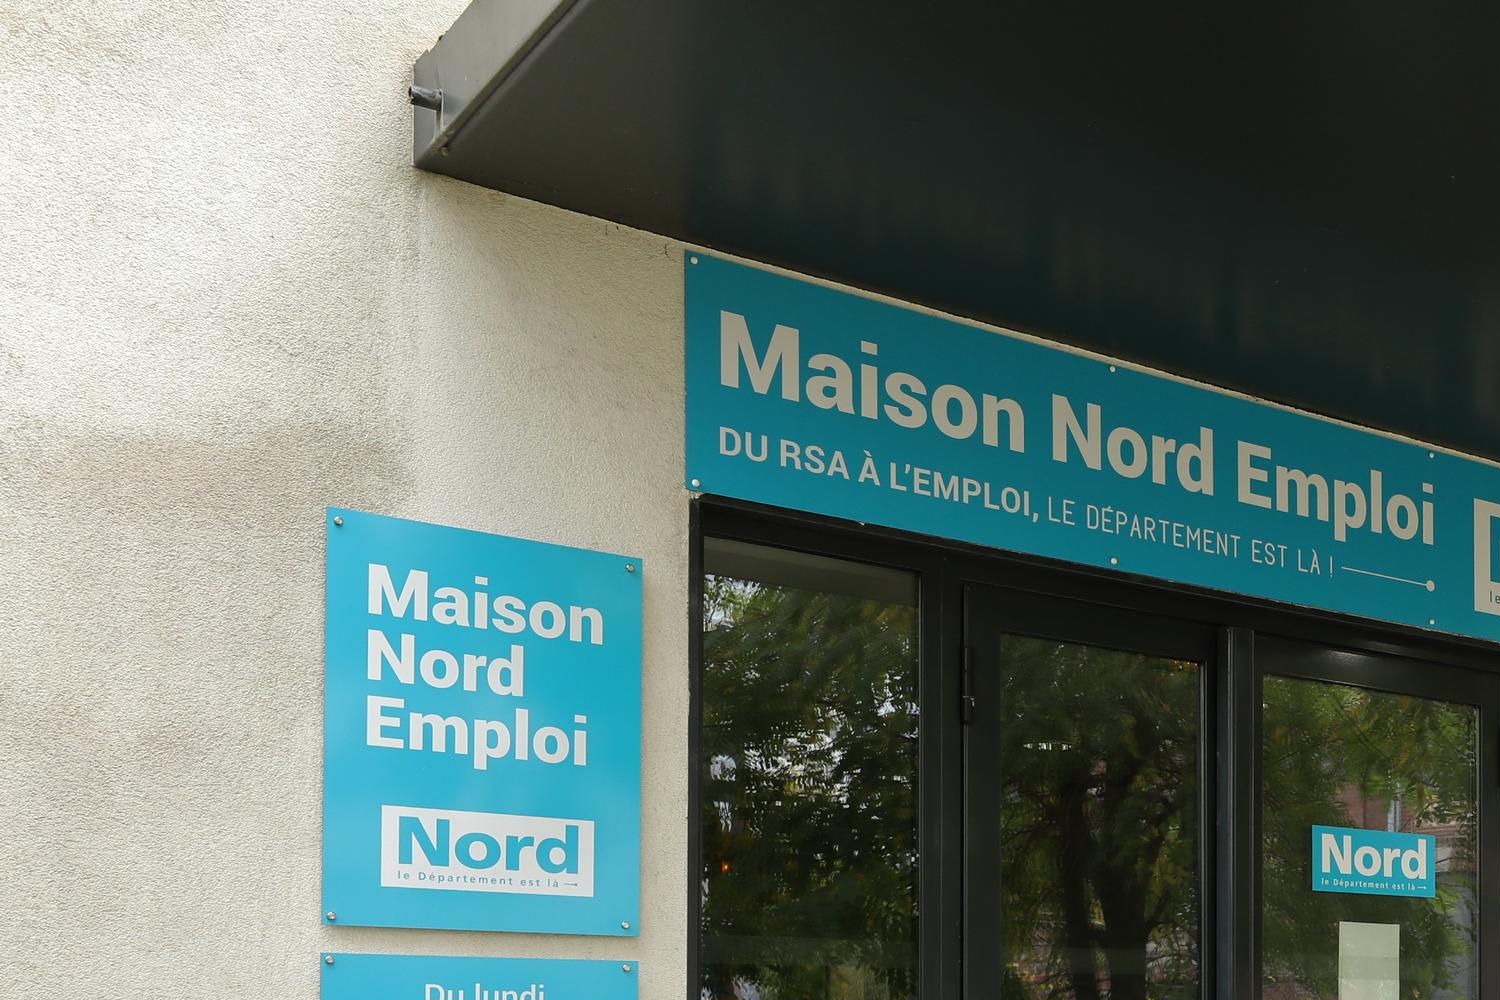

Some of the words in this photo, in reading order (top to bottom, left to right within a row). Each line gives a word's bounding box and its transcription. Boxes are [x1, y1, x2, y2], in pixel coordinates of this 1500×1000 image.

[720, 310, 1026, 454] Maison
[1052, 394, 1215, 496] Nord
[1237, 440, 1435, 546] Emploi
[719, 426, 768, 463] DU
[780, 438, 850, 480] RSA
[858, 449, 881, 486] À
[889, 461, 1040, 524] L’EMPLOI,
[1048, 496, 1076, 526] LE
[1086, 504, 1241, 559] DÉPARTEMENT
[1251, 539, 1288, 568] EST
[367, 562, 604, 646] Maison
[1489, 590, 1500, 604] le
[367, 628, 525, 698] Nord
[366, 694, 588, 771] Emploi
[398, 816, 580, 875] Nord
[1321, 832, 1427, 880] Nord
[397, 870, 410, 880] le
[418, 871, 513, 887] Département
[520, 879, 540, 887] est
[547, 879, 559, 888] là
[1333, 879, 1389, 889] Département
